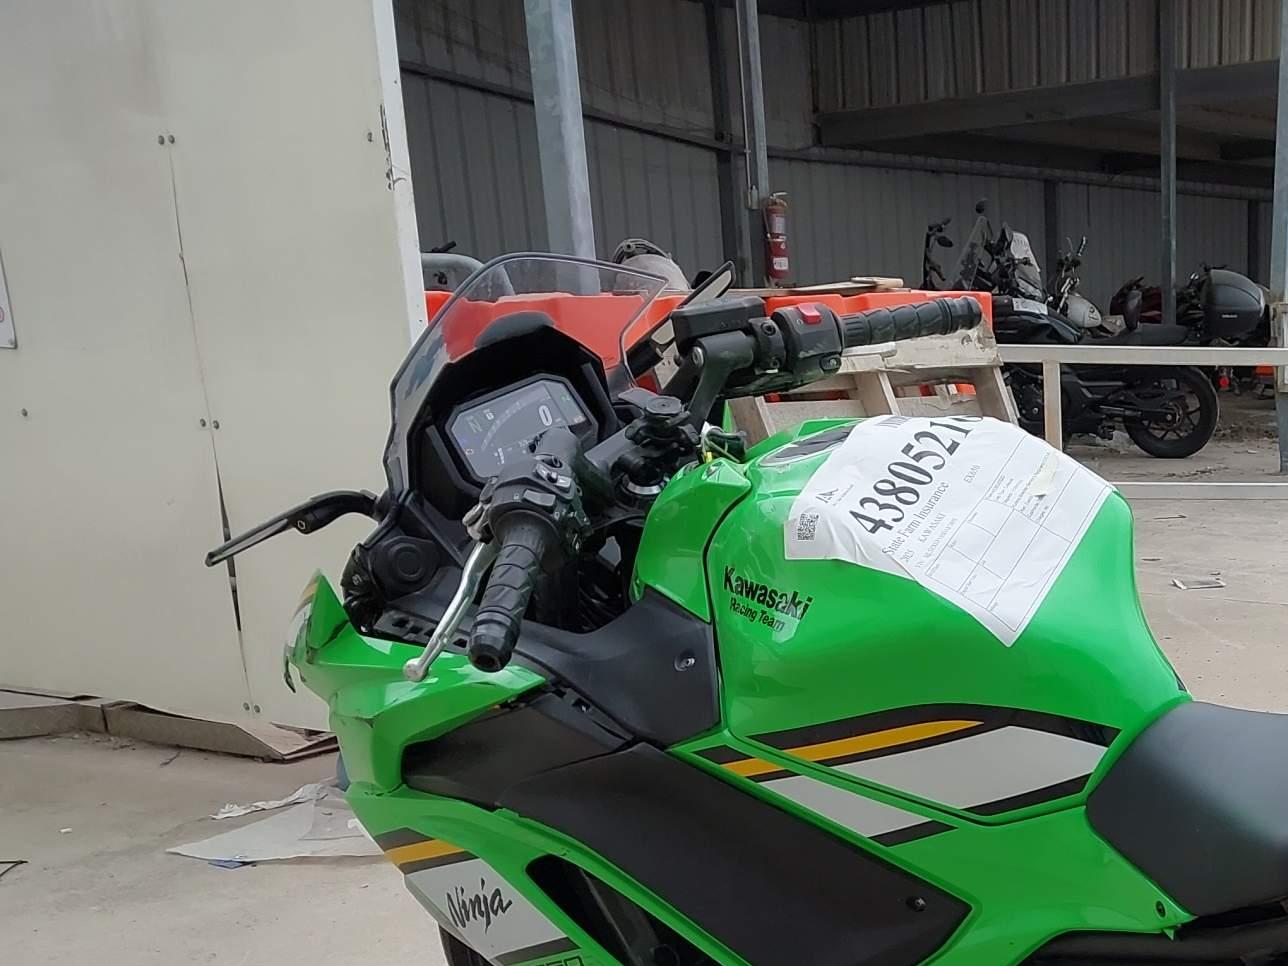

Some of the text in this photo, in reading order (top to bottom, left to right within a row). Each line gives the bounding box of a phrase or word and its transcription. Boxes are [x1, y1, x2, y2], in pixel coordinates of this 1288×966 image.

[881, 536, 905, 555] State
[897, 519, 921, 538] Farm
[913, 482, 949, 520] Insurance
[723, 565, 814, 621] Kawasaki
[729, 597, 786, 632] Racing Team
[446, 877, 513, 934] Ninja
